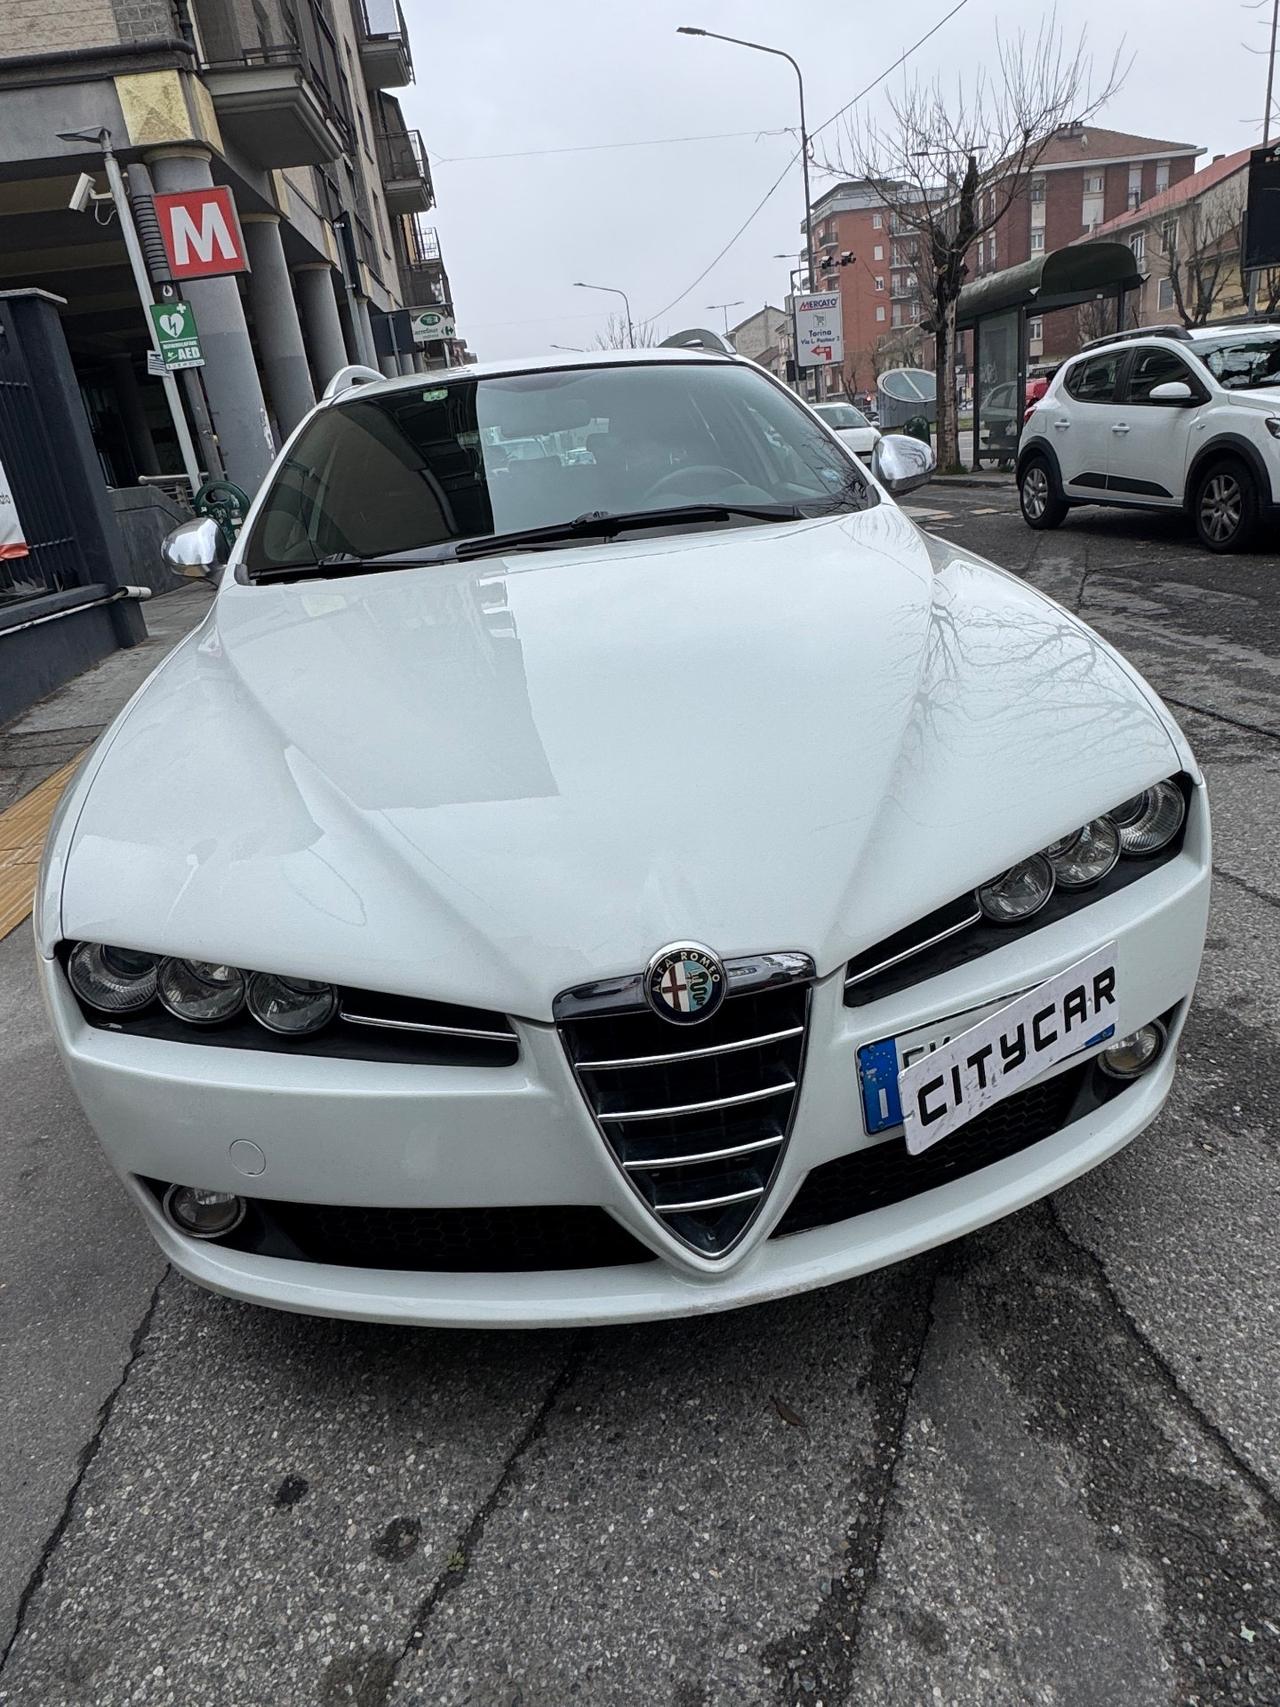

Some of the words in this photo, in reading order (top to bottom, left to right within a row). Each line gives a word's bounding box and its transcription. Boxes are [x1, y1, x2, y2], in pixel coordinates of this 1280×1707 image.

[170, 202, 238, 265] M
[809, 329, 832, 338] Torino
[178, 347, 200, 360] AED
[652, 958, 674, 993] ALFA
[680, 952, 721, 983] ROMEO
[917, 966, 1117, 1127] CITYCAR
[878, 1088, 889, 1119] I
